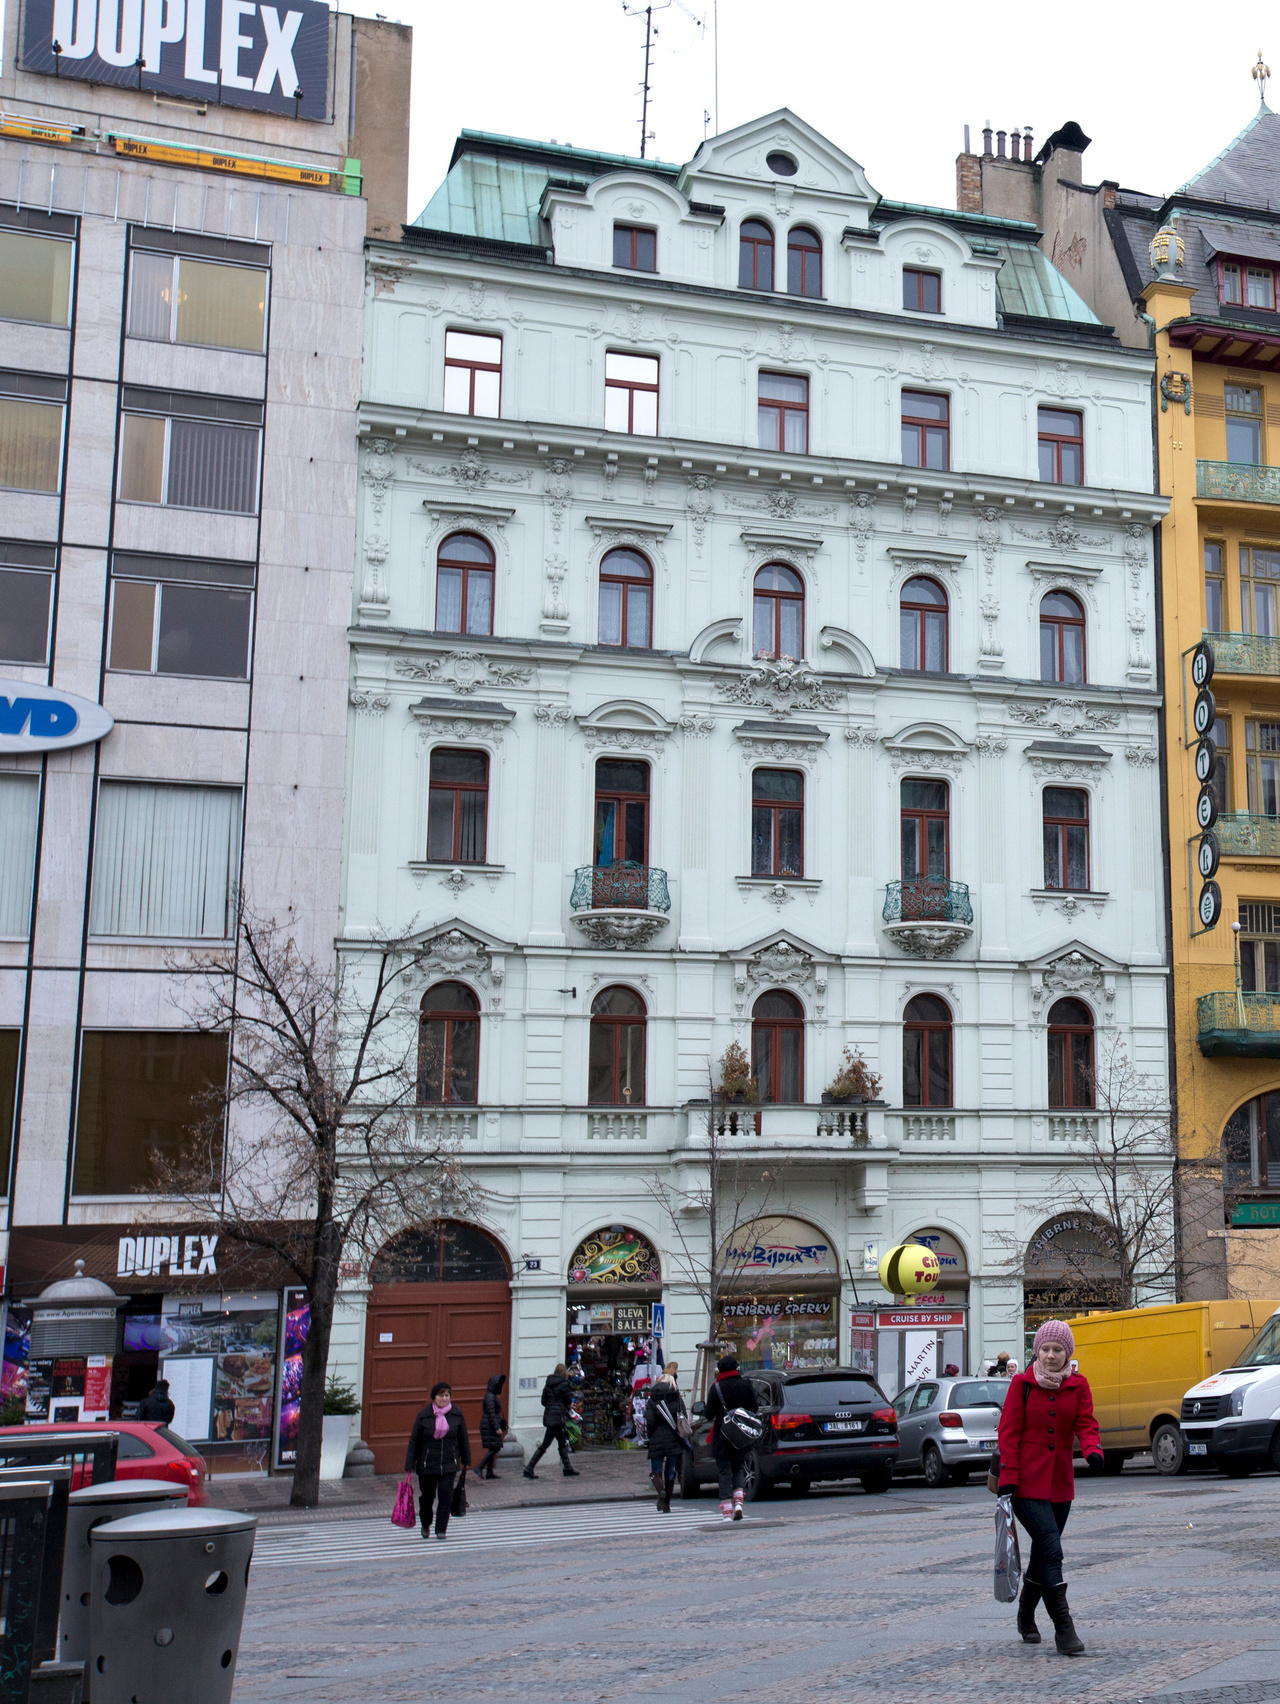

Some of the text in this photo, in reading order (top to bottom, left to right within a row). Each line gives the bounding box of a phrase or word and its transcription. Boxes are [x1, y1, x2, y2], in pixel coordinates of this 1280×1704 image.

[52, 0, 304, 97] DUPLEX
[123, 142, 148, 155] DUPLEX
[212, 157, 236, 168] DUPLEX
[300, 172, 323, 183] DUPLEX
[117, 1235, 219, 1277] DUPLEX
[753, 1246, 804, 1269] Bijoux
[922, 1256, 938, 1269] Cit
[618, 1308, 643, 1318] SLEVA
[723, 1301, 831, 1317] STŘÍBRNÉ ŠPERKY
[617, 1320, 643, 1330] SALE
[890, 1314, 952, 1323] CRUISE BY SHIP
[906, 1339, 936, 1376] MARTIN
